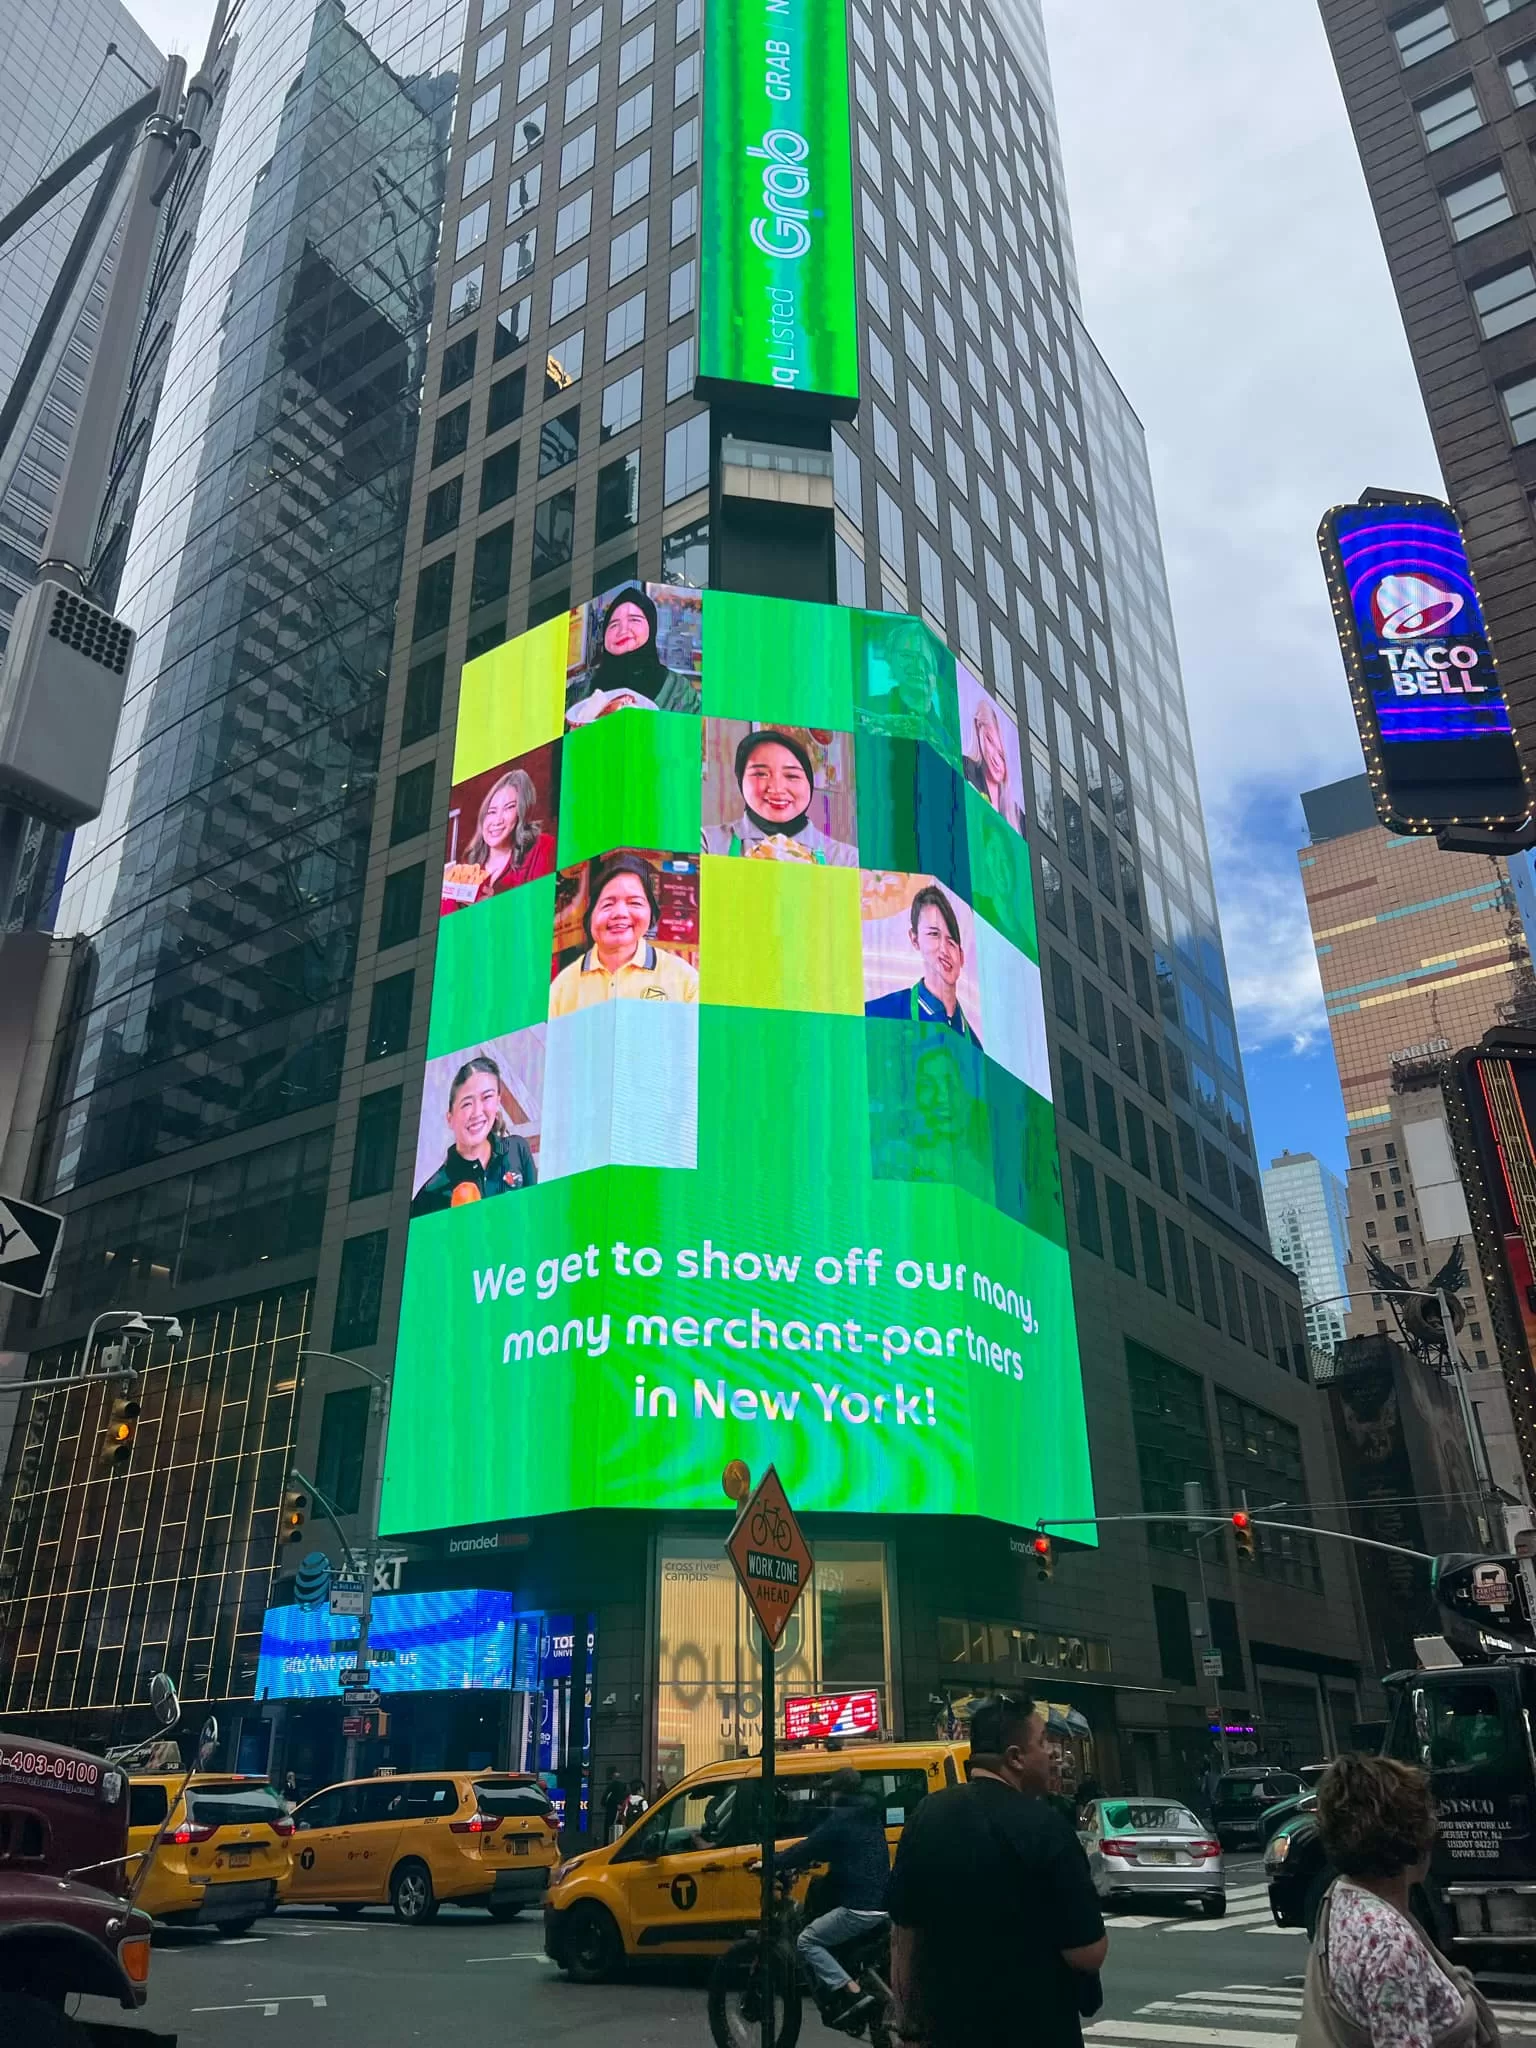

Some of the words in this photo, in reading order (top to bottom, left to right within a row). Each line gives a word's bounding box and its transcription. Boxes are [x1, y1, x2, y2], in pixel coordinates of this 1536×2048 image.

[765, 40, 792, 101] GRAB
[746, 128, 811, 260] Grab
[765, 286, 796, 362] Listed
[1378, 644, 1479, 671] TACO
[1391, 670, 1485, 696] BELL
[472, 1263, 526, 1304] We
[535, 1244, 600, 1300] get
[611, 1242, 663, 1277] to
[676, 1239, 802, 1282] show
[814, 1247, 883, 1287] off
[895, 1259, 967, 1291] our
[973, 1271, 1039, 1335] many,
[502, 1314, 611, 1364] many
[626, 1308, 1024, 1381] merchant-partners
[634, 1374, 677, 1418] in
[693, 1378, 801, 1421] New
[811, 1382, 937, 1427] York!
[449, 1533, 499, 1553] branded
[664, 1561, 694, 1572] cross
[695, 1560, 721, 1572] river
[665, 1572, 709, 1583] campus
[749, 1554, 774, 1579] WORK
[775, 1560, 798, 1583] ZONE
[755, 1584, 790, 1604] AHEAD
[400, 1652, 418, 1665] us
[676, 1880, 692, 1906] T
